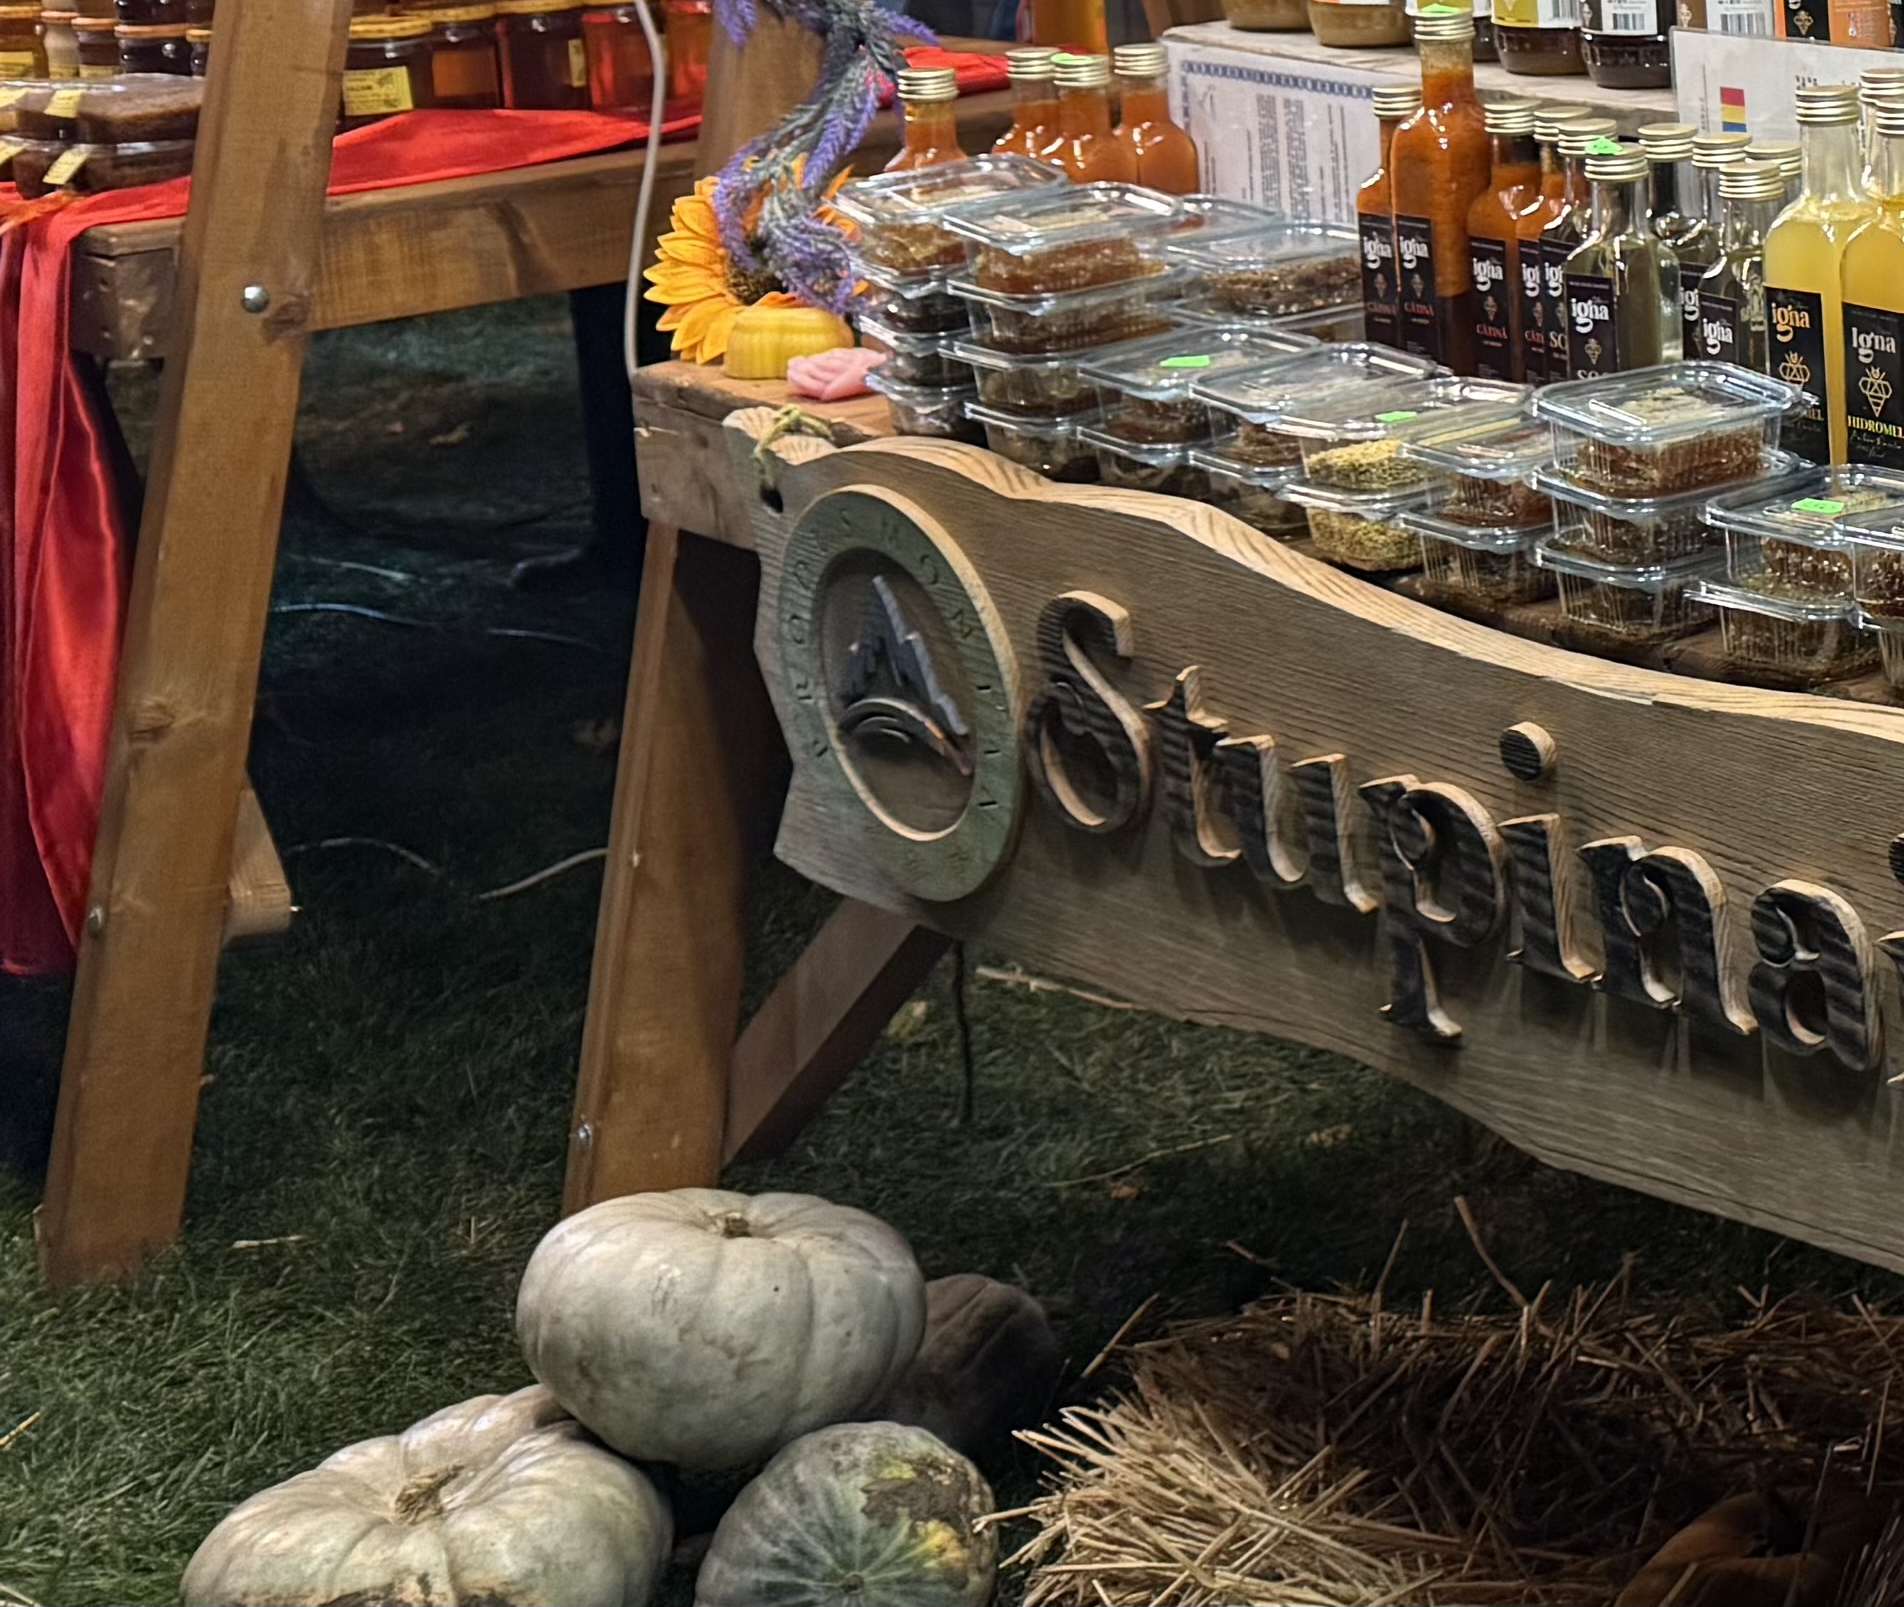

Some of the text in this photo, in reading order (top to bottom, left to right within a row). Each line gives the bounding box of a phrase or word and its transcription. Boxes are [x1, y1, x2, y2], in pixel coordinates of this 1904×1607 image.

[1772, 303, 1810, 342] igna
[1852, 327, 1896, 363] Igna
[1848, 415, 1904, 439] HIDROMEL
